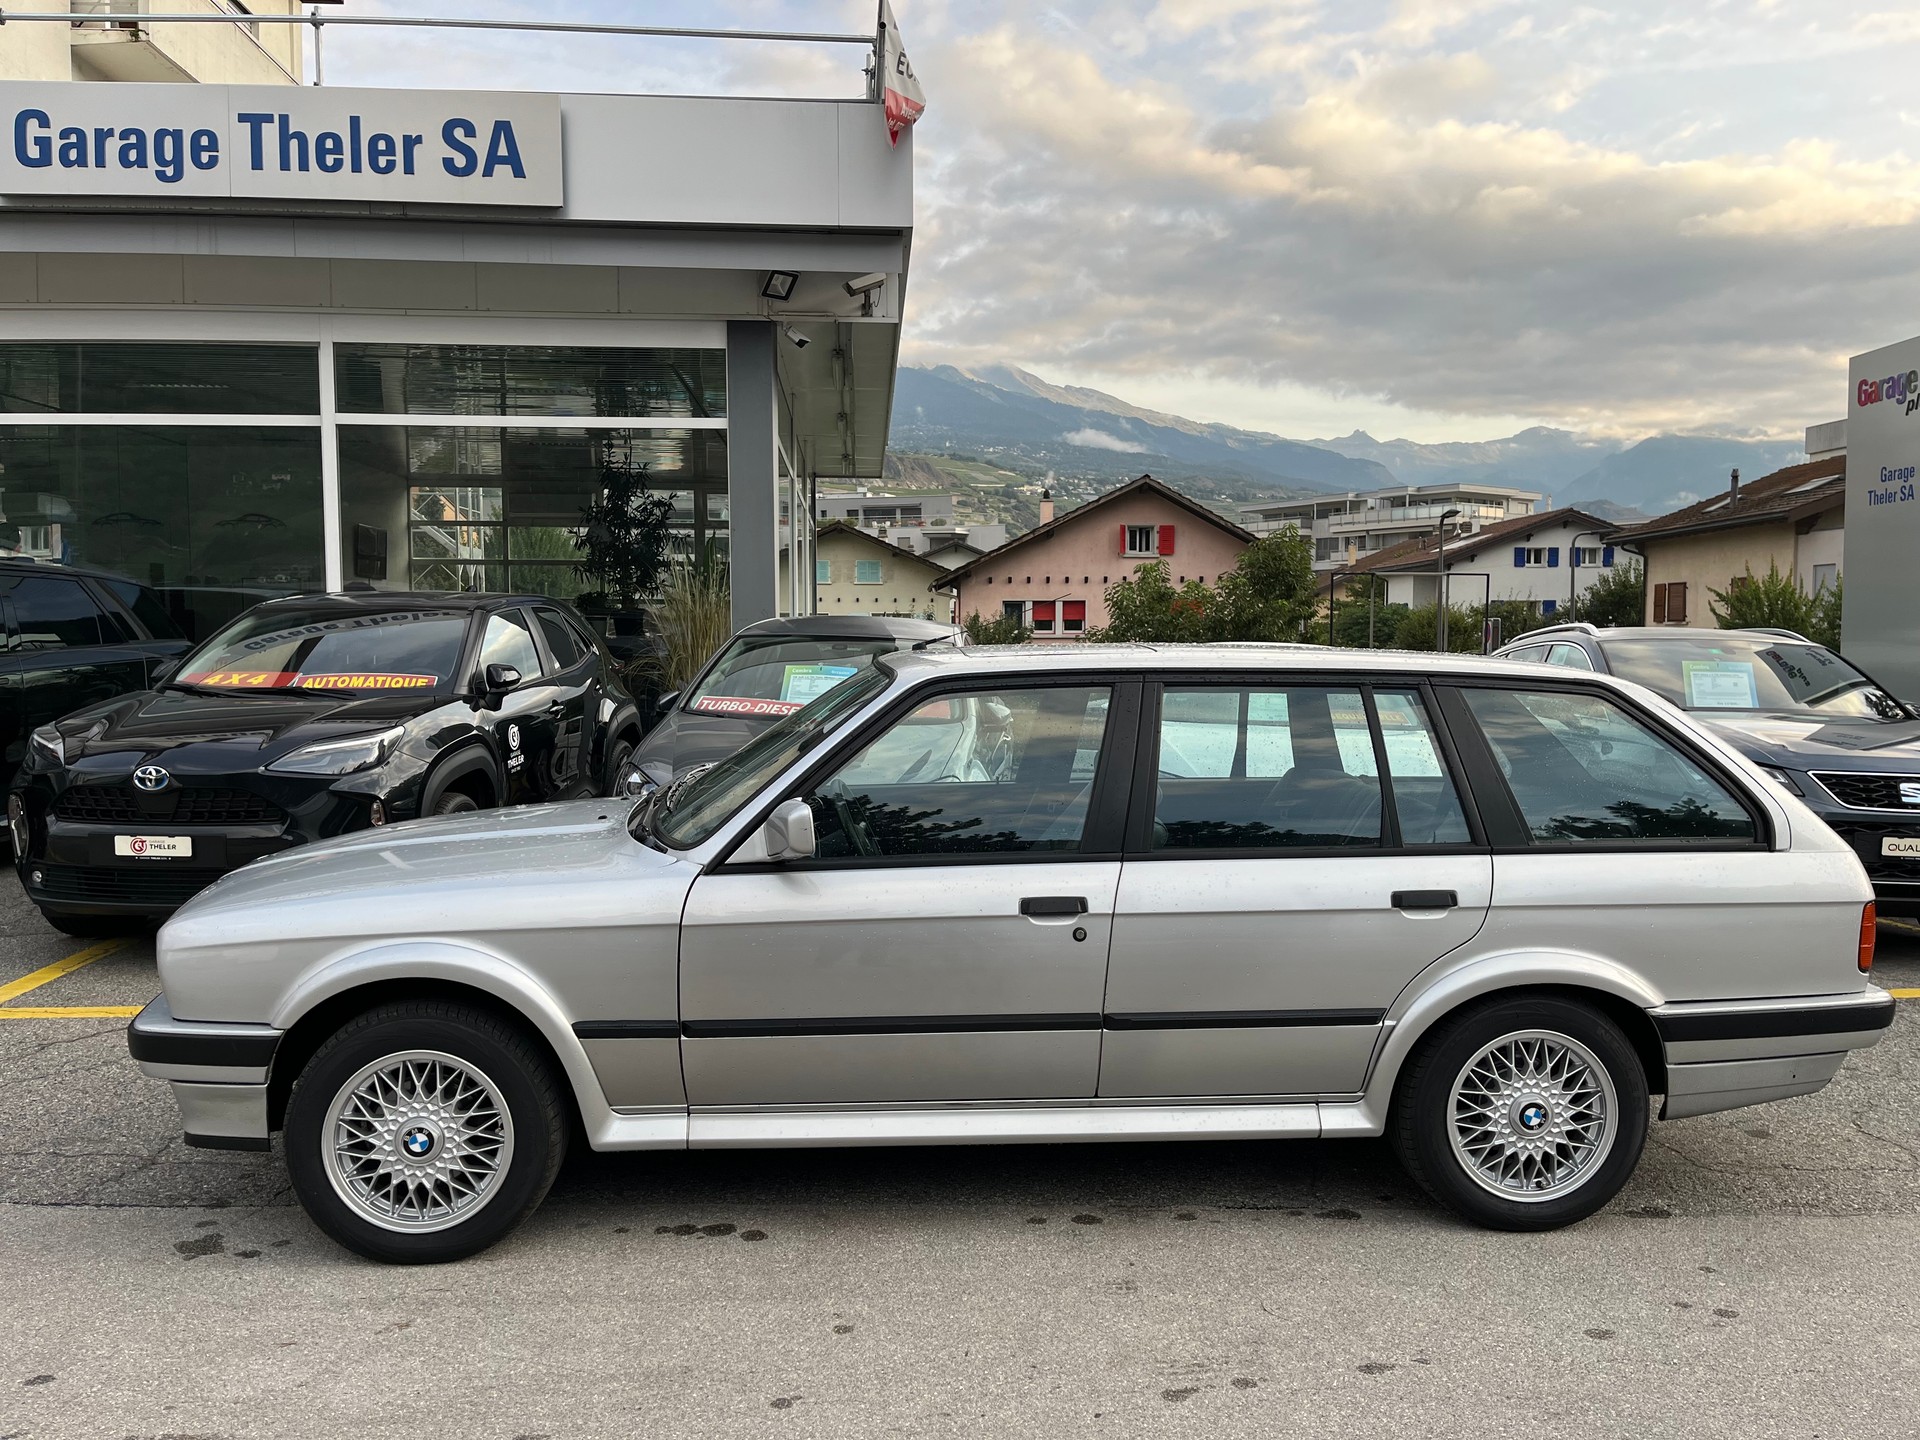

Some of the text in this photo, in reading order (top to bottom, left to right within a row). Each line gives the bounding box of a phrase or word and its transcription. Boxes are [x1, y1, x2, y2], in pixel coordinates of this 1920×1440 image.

[14, 108, 527, 183] Garage Theler SA
[1857, 369, 1919, 407] Garage
[1880, 466, 1915, 483] Garage
[1868, 484, 1915, 506] Theler SA
[302, 675, 429, 689] AUTOMATIQUE
